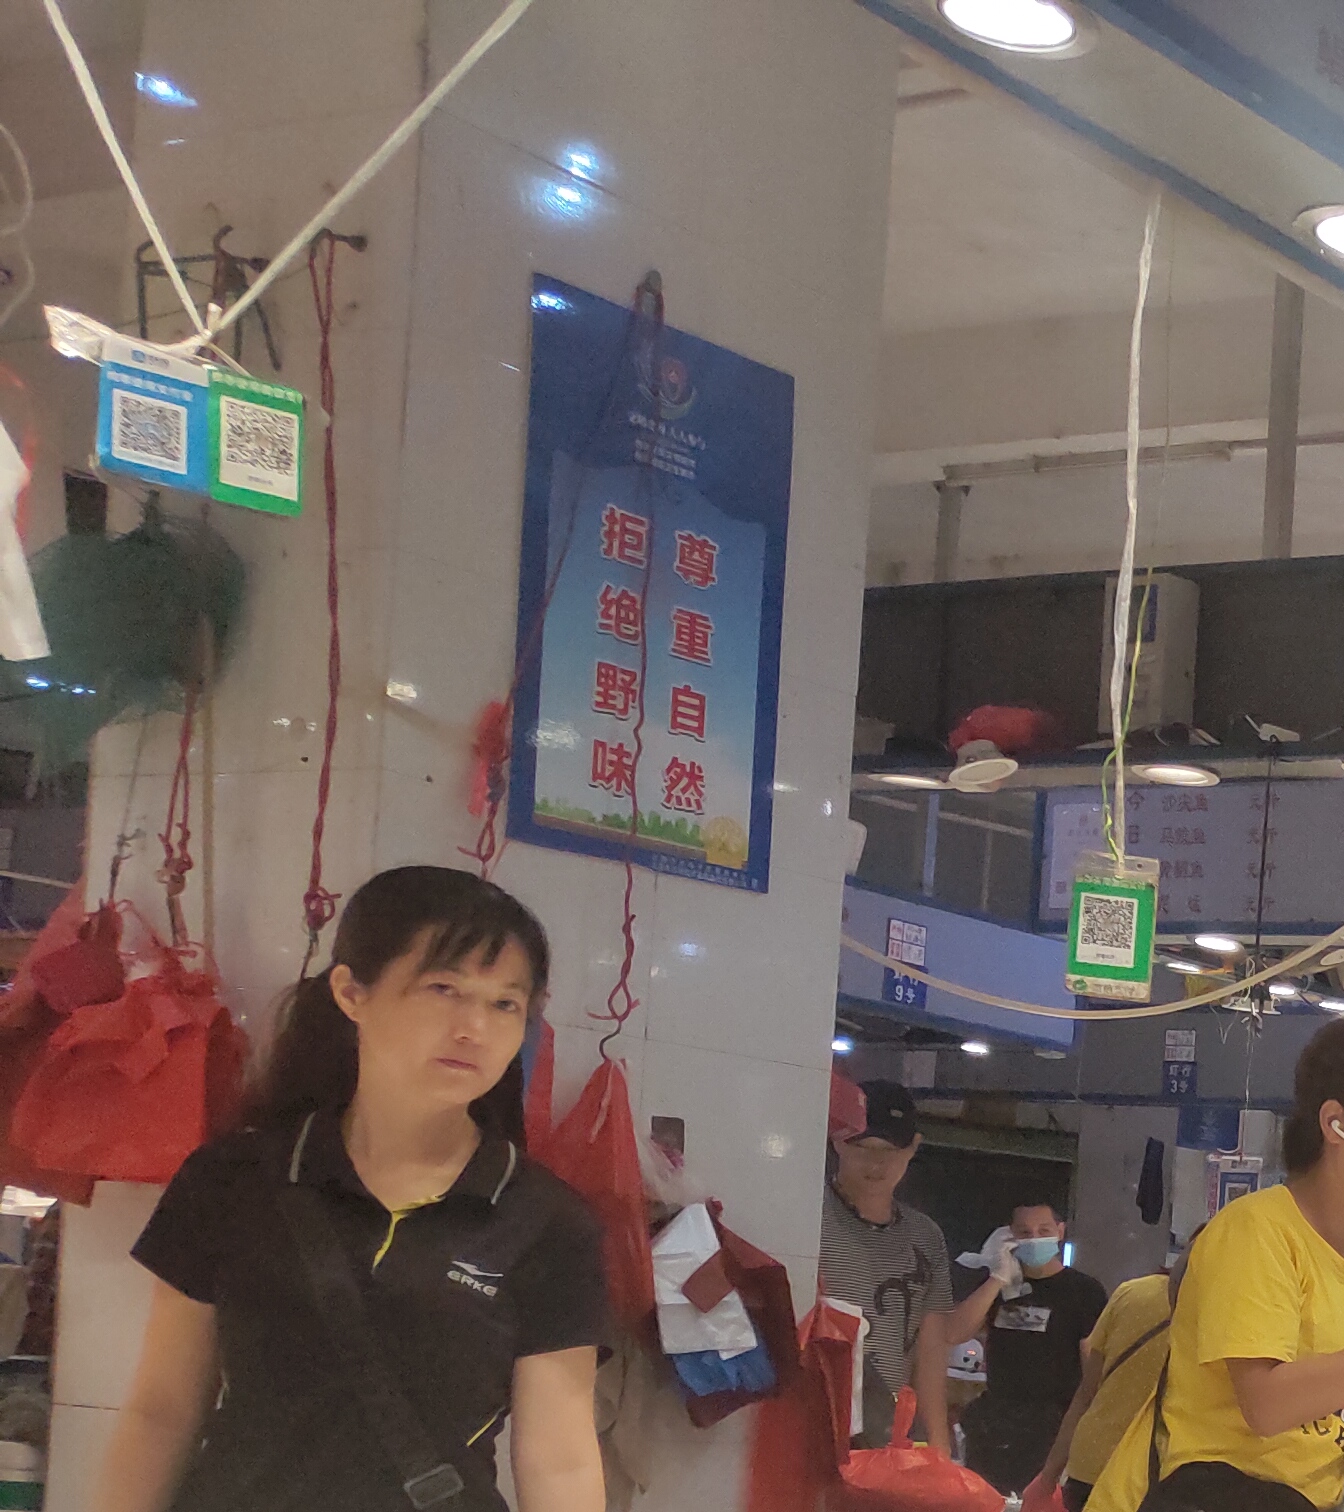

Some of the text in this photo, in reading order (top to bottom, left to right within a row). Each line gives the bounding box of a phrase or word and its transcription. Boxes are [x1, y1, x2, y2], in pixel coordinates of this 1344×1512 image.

[589, 504, 648, 797] 拒绝野味
[663, 530, 719, 815] 尊重自然
